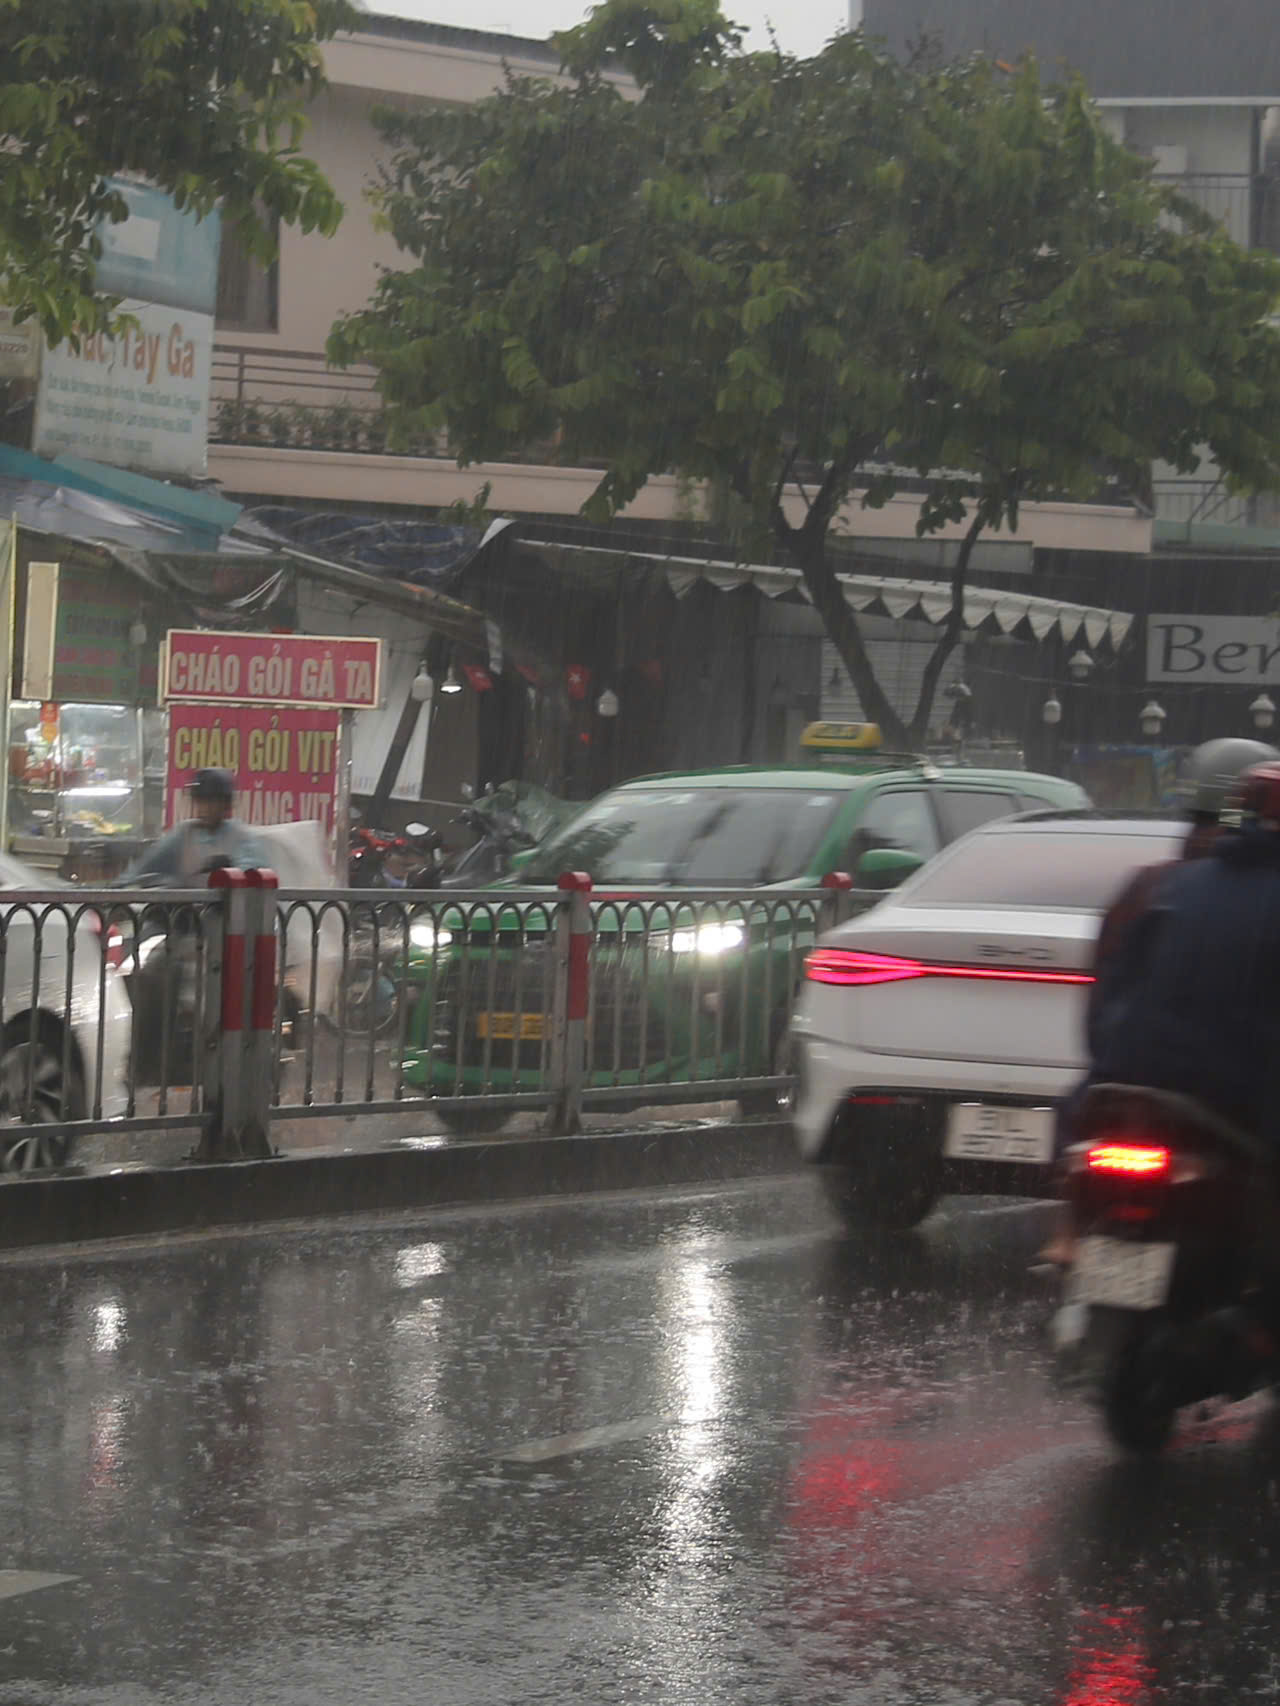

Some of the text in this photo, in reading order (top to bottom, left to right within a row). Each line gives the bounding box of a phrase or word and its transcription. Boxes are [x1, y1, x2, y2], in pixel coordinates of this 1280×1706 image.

[167, 322, 196, 379] Ga
[171, 644, 374, 699] CHÁO GỎI GÀ TA
[248, 715, 291, 772] GỎI
[298, 730, 336, 783] VỊT
